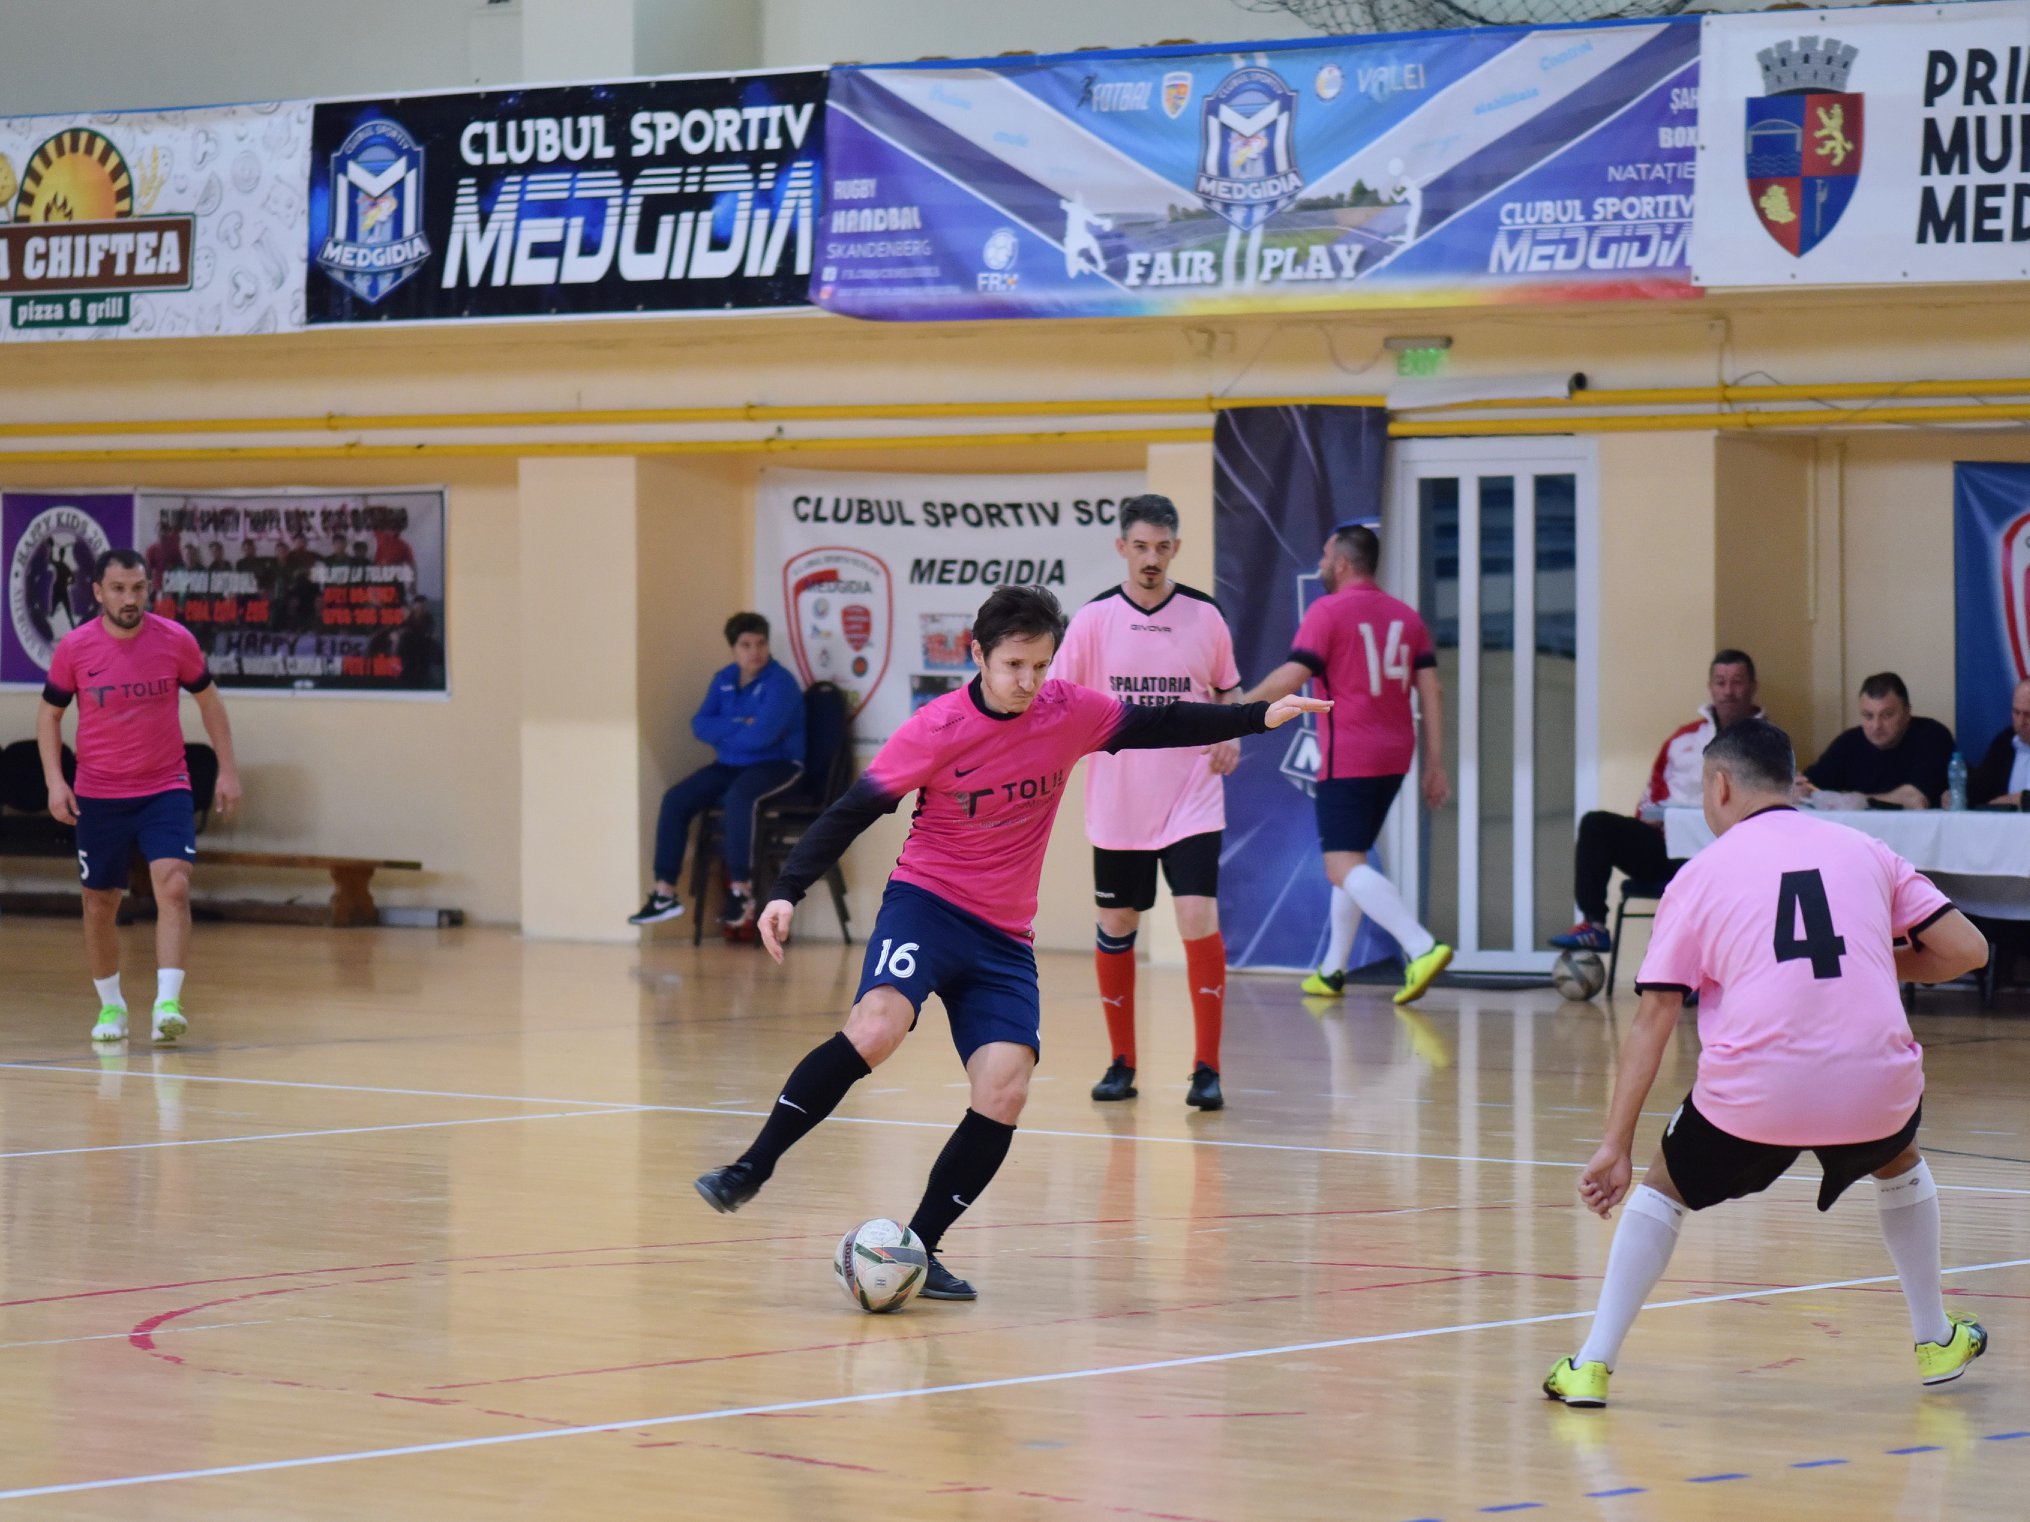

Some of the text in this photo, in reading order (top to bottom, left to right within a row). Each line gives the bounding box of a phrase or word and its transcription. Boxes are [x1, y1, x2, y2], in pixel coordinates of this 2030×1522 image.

[1923, 46, 2030, 107] PRI
[460, 103, 816, 166] CLUBUL SPORTIV
[1659, 126, 1699, 149] BOX
[1920, 113, 2030, 176] MU
[833, 178, 877, 200] RUGBY
[1198, 172, 1303, 200] MEDGIDIA
[831, 206, 922, 233] HANDBAL
[1499, 194, 1695, 225] CLUBUL SPORTIV
[23, 230, 182, 280] CHIFTEA
[322, 236, 428, 267] MEDGIDIA
[826, 239, 932, 260] SKANDENBERG
[1126, 244, 1365, 287] FAIR PLAY
[17, 300, 64, 326] pizza
[86, 296, 124, 325] grill
[56, 510, 89, 535] KIDS
[791, 495, 915, 527] CLUBUL
[924, 500, 1060, 529] SPORTIV
[909, 558, 1066, 587] MEDGIDIA
[1130, 624, 1173, 633] GIVOVA
[1358, 620, 1410, 698] 14
[1110, 676, 1192, 693] SPALATORIA
[1773, 868, 1846, 979] 4
[874, 938, 920, 979] 16
